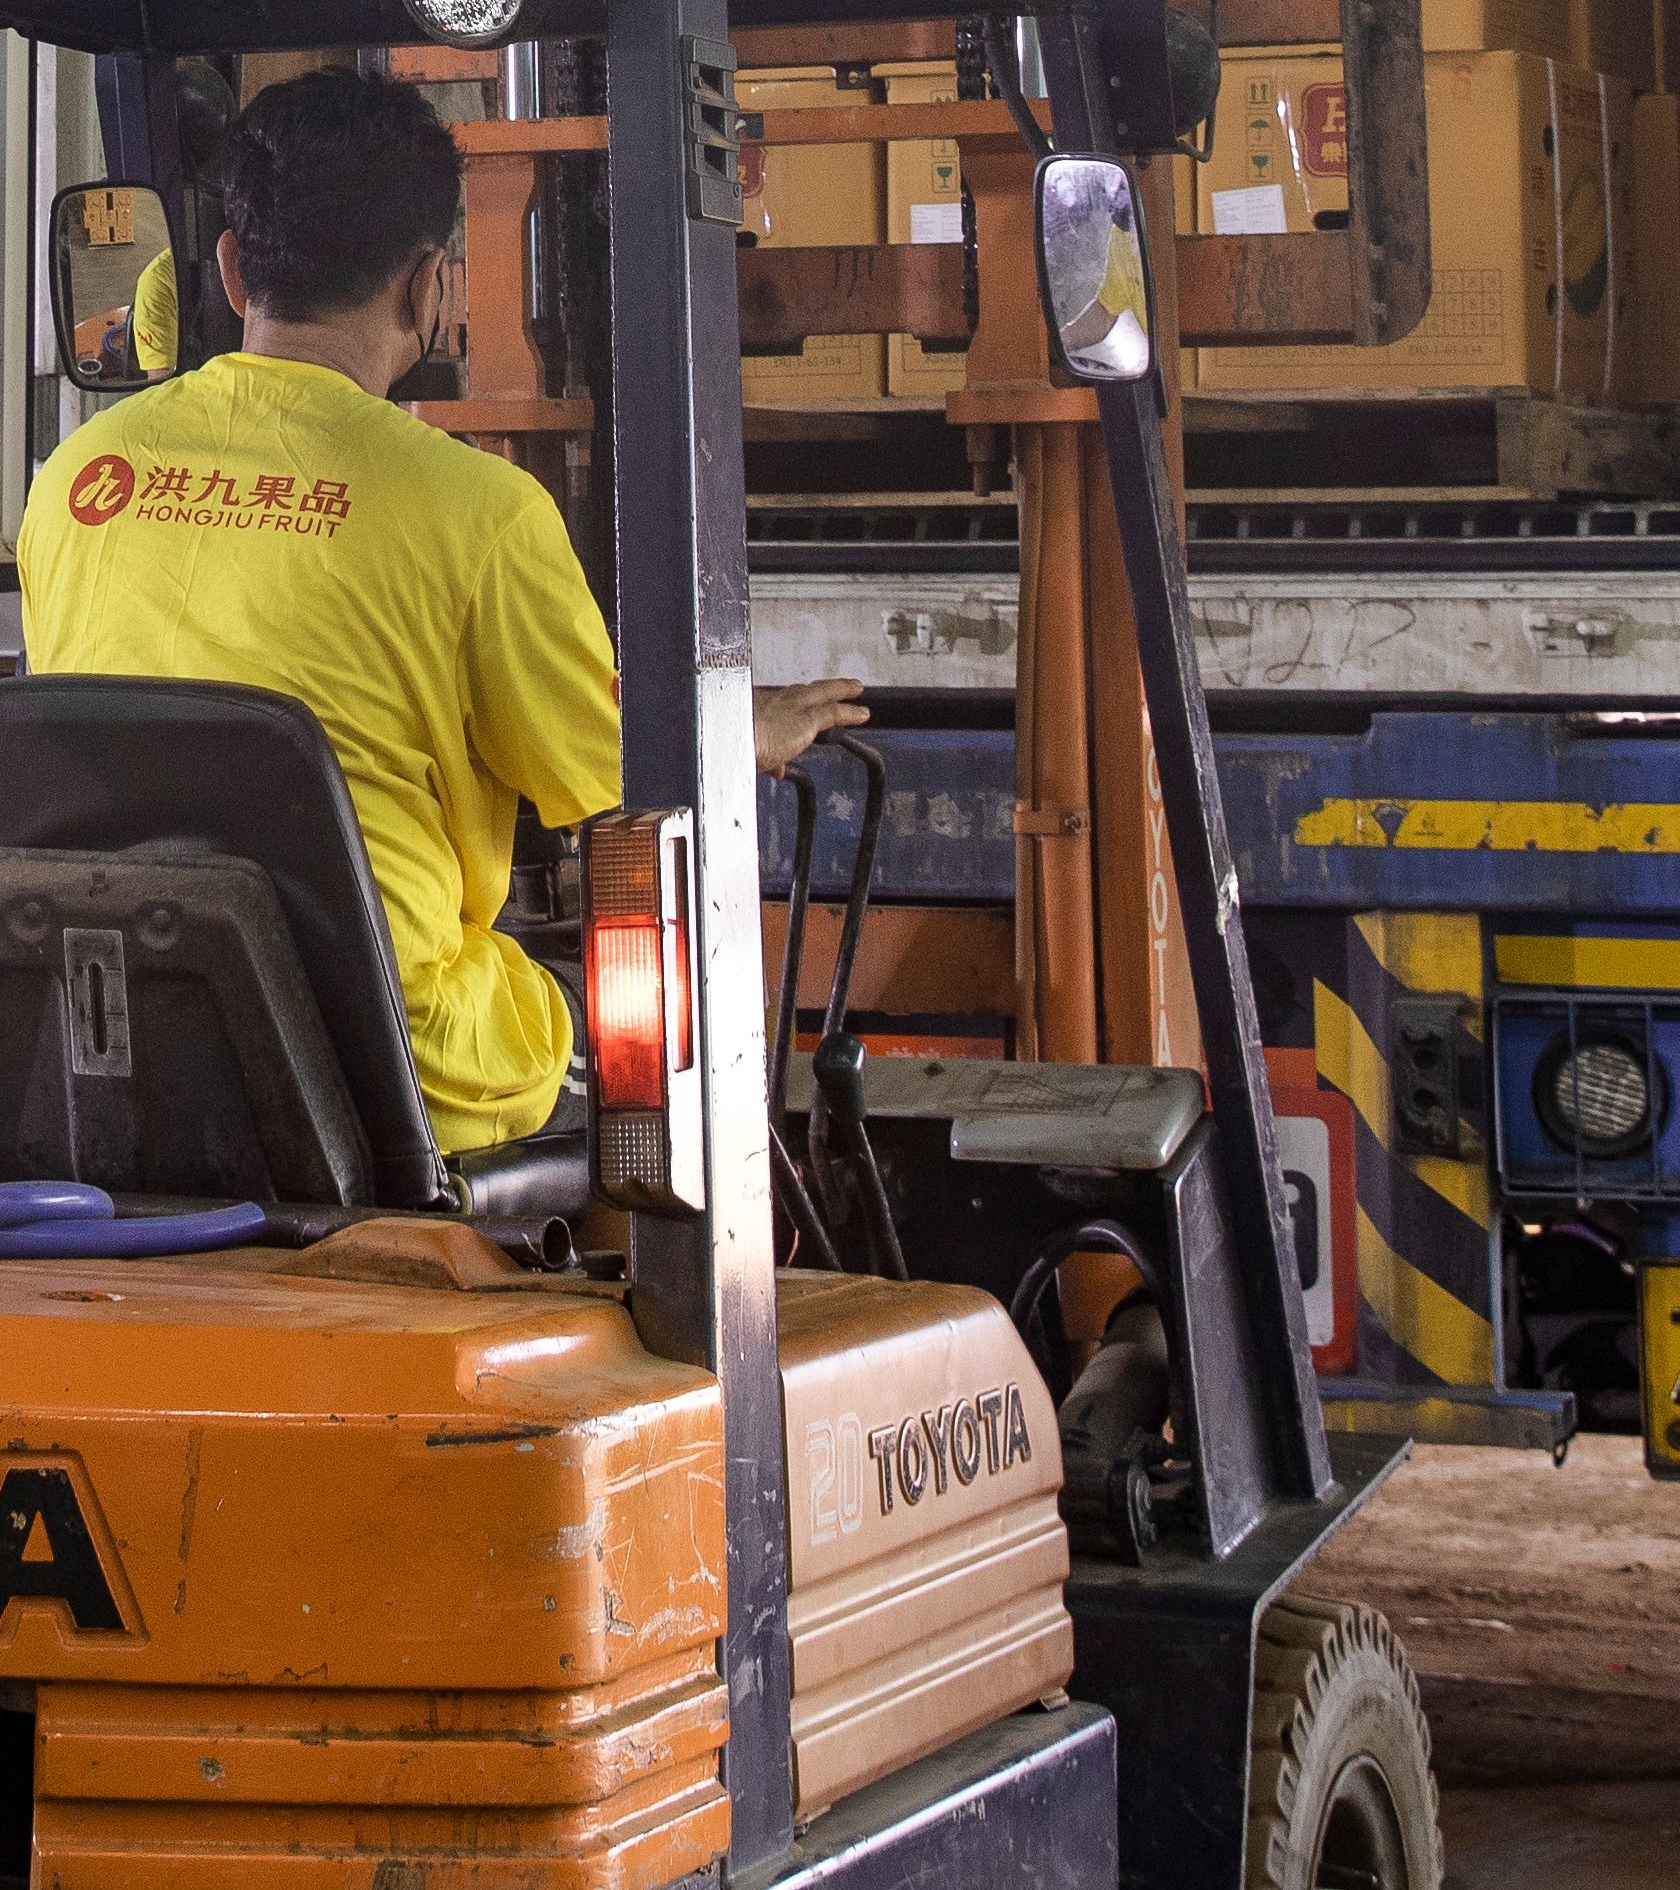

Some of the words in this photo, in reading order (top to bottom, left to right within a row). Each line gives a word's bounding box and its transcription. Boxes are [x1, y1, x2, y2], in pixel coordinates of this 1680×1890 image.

[135, 504, 259, 531] HONGJIU
[258, 512, 343, 539] FRUIT
[139, 465, 353, 519] 洪九果品
[1147, 747, 1172, 1069] OYOTA
[867, 1381, 1032, 1518] TOYOTA
